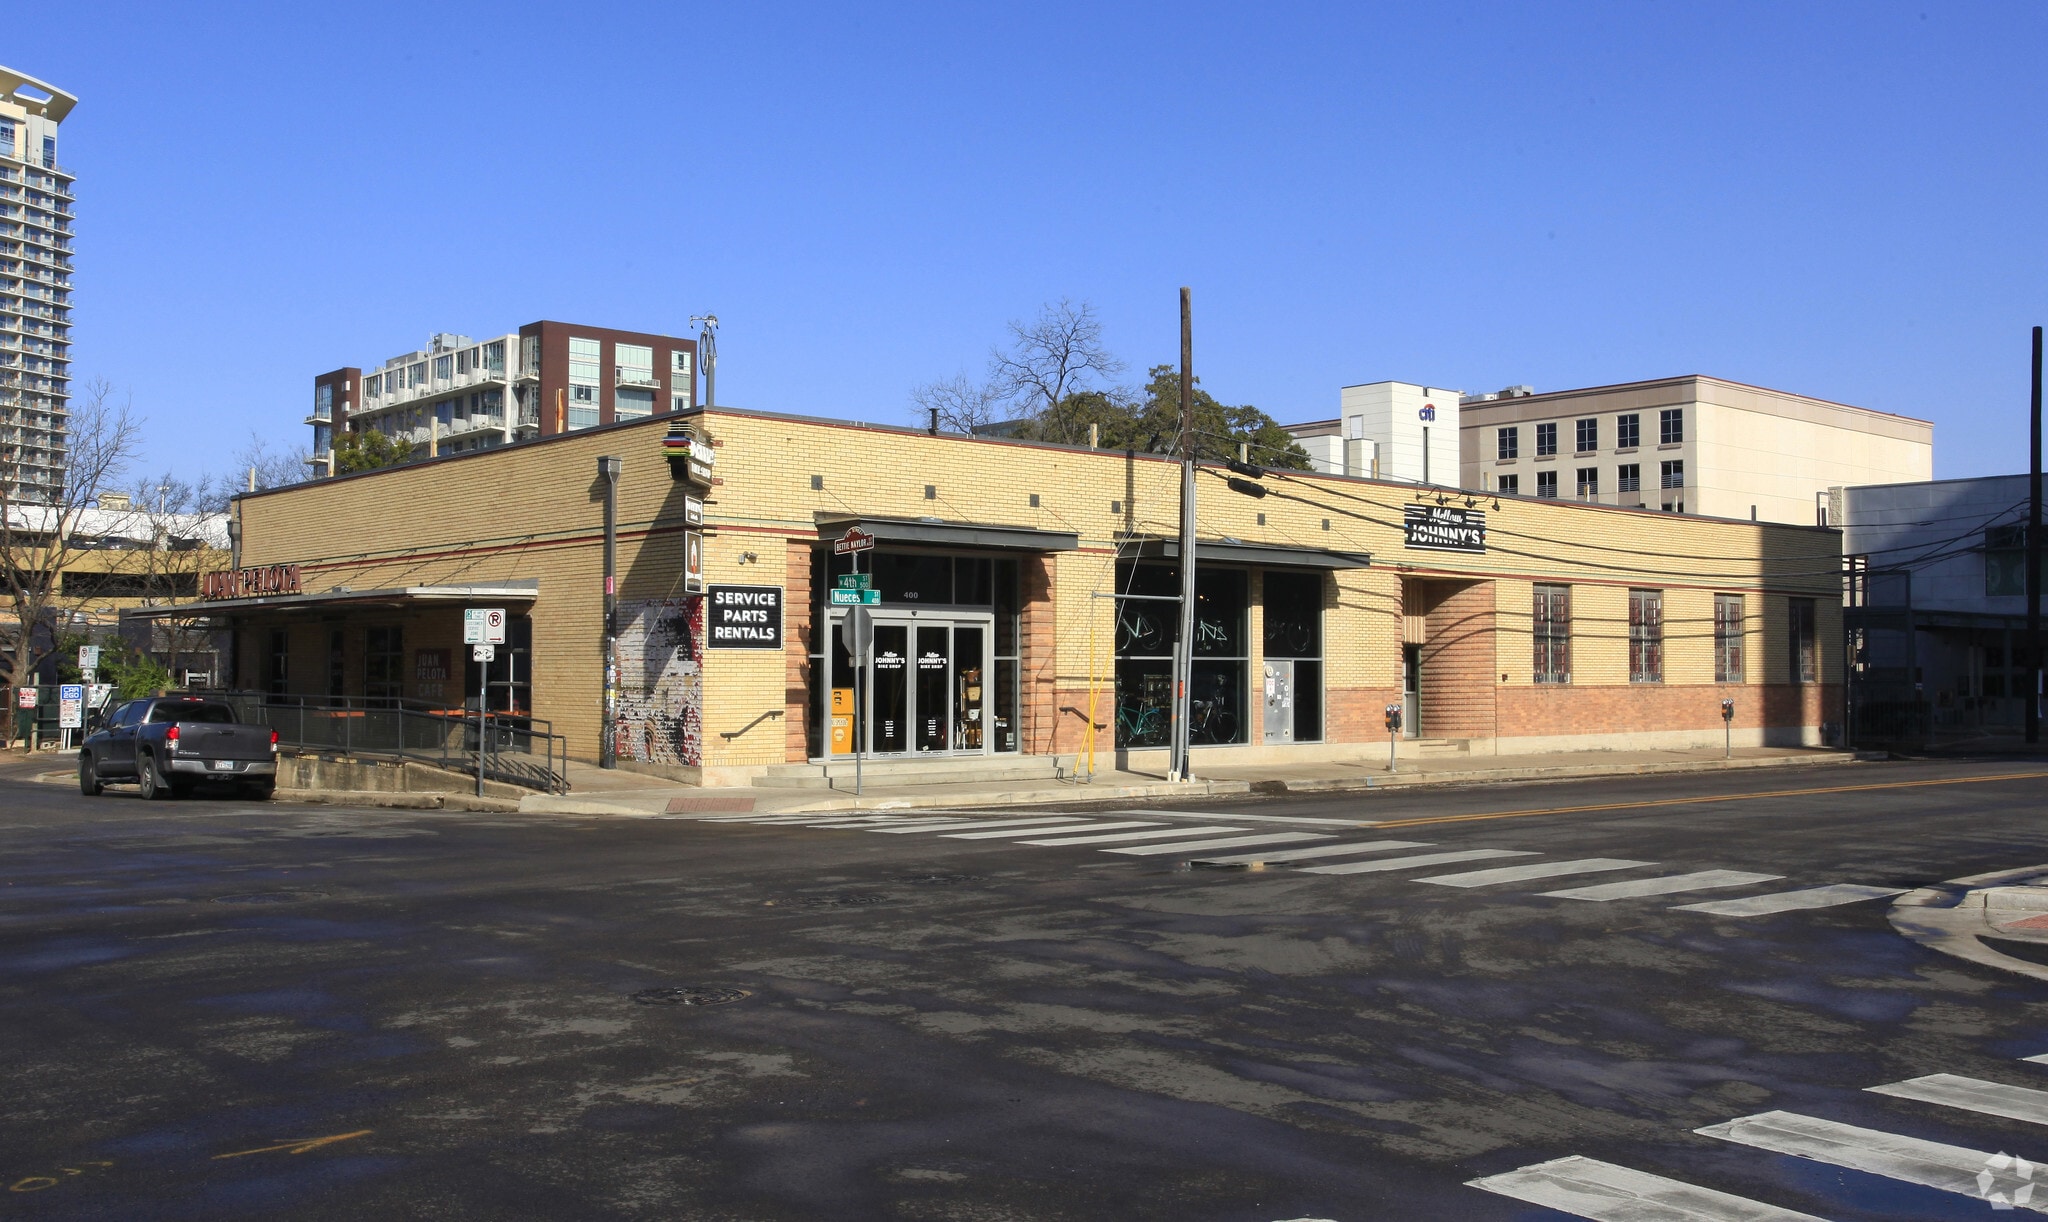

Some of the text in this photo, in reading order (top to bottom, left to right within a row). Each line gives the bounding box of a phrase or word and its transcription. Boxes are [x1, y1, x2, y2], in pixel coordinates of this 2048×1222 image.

[1411, 524, 1481, 545] JOHNNY'S
[836, 541, 850, 552] BETTIE
[850, 539, 867, 550] NAYLOR
[241, 564, 300, 594] PELOTA
[843, 577, 857, 588] 4th
[715, 591, 776, 606] SERVICE
[834, 591, 861, 603] Nueces
[723, 609, 768, 623] PARTS
[715, 626, 775, 640] RENTALS
[417, 654, 440, 667] JUAN
[416, 667, 447, 680] PELOTA
